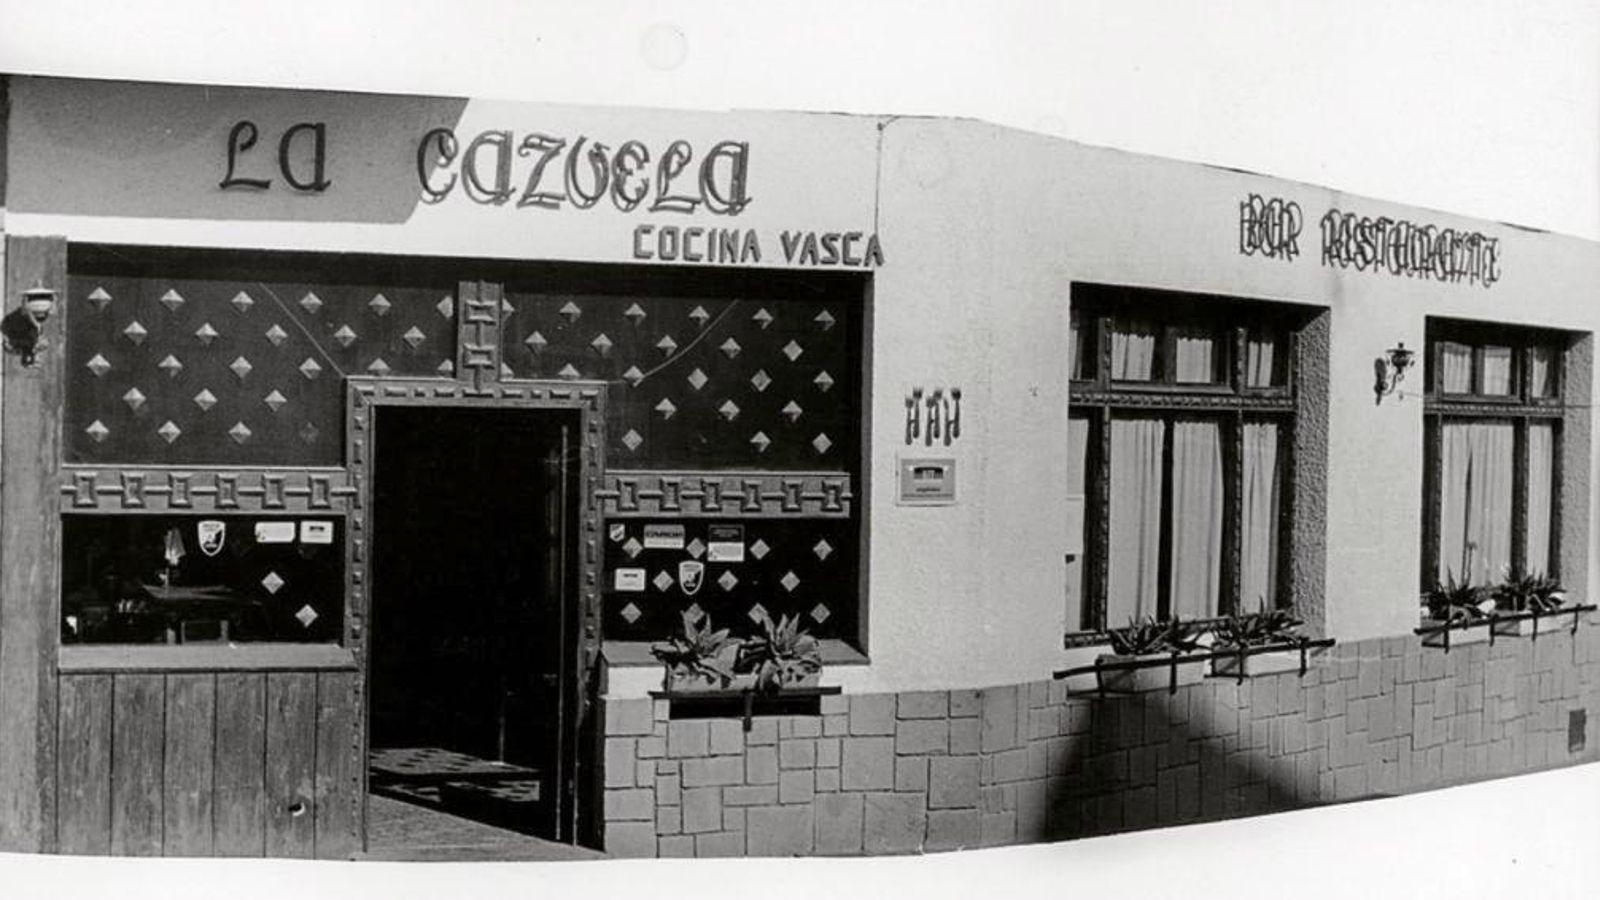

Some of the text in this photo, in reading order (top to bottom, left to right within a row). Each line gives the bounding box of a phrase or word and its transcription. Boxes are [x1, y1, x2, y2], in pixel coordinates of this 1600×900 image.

[220, 121, 752, 216] LA CAZUELA
[634, 224, 886, 267] COCINA VASCA
[1240, 193, 1303, 262] BAR
